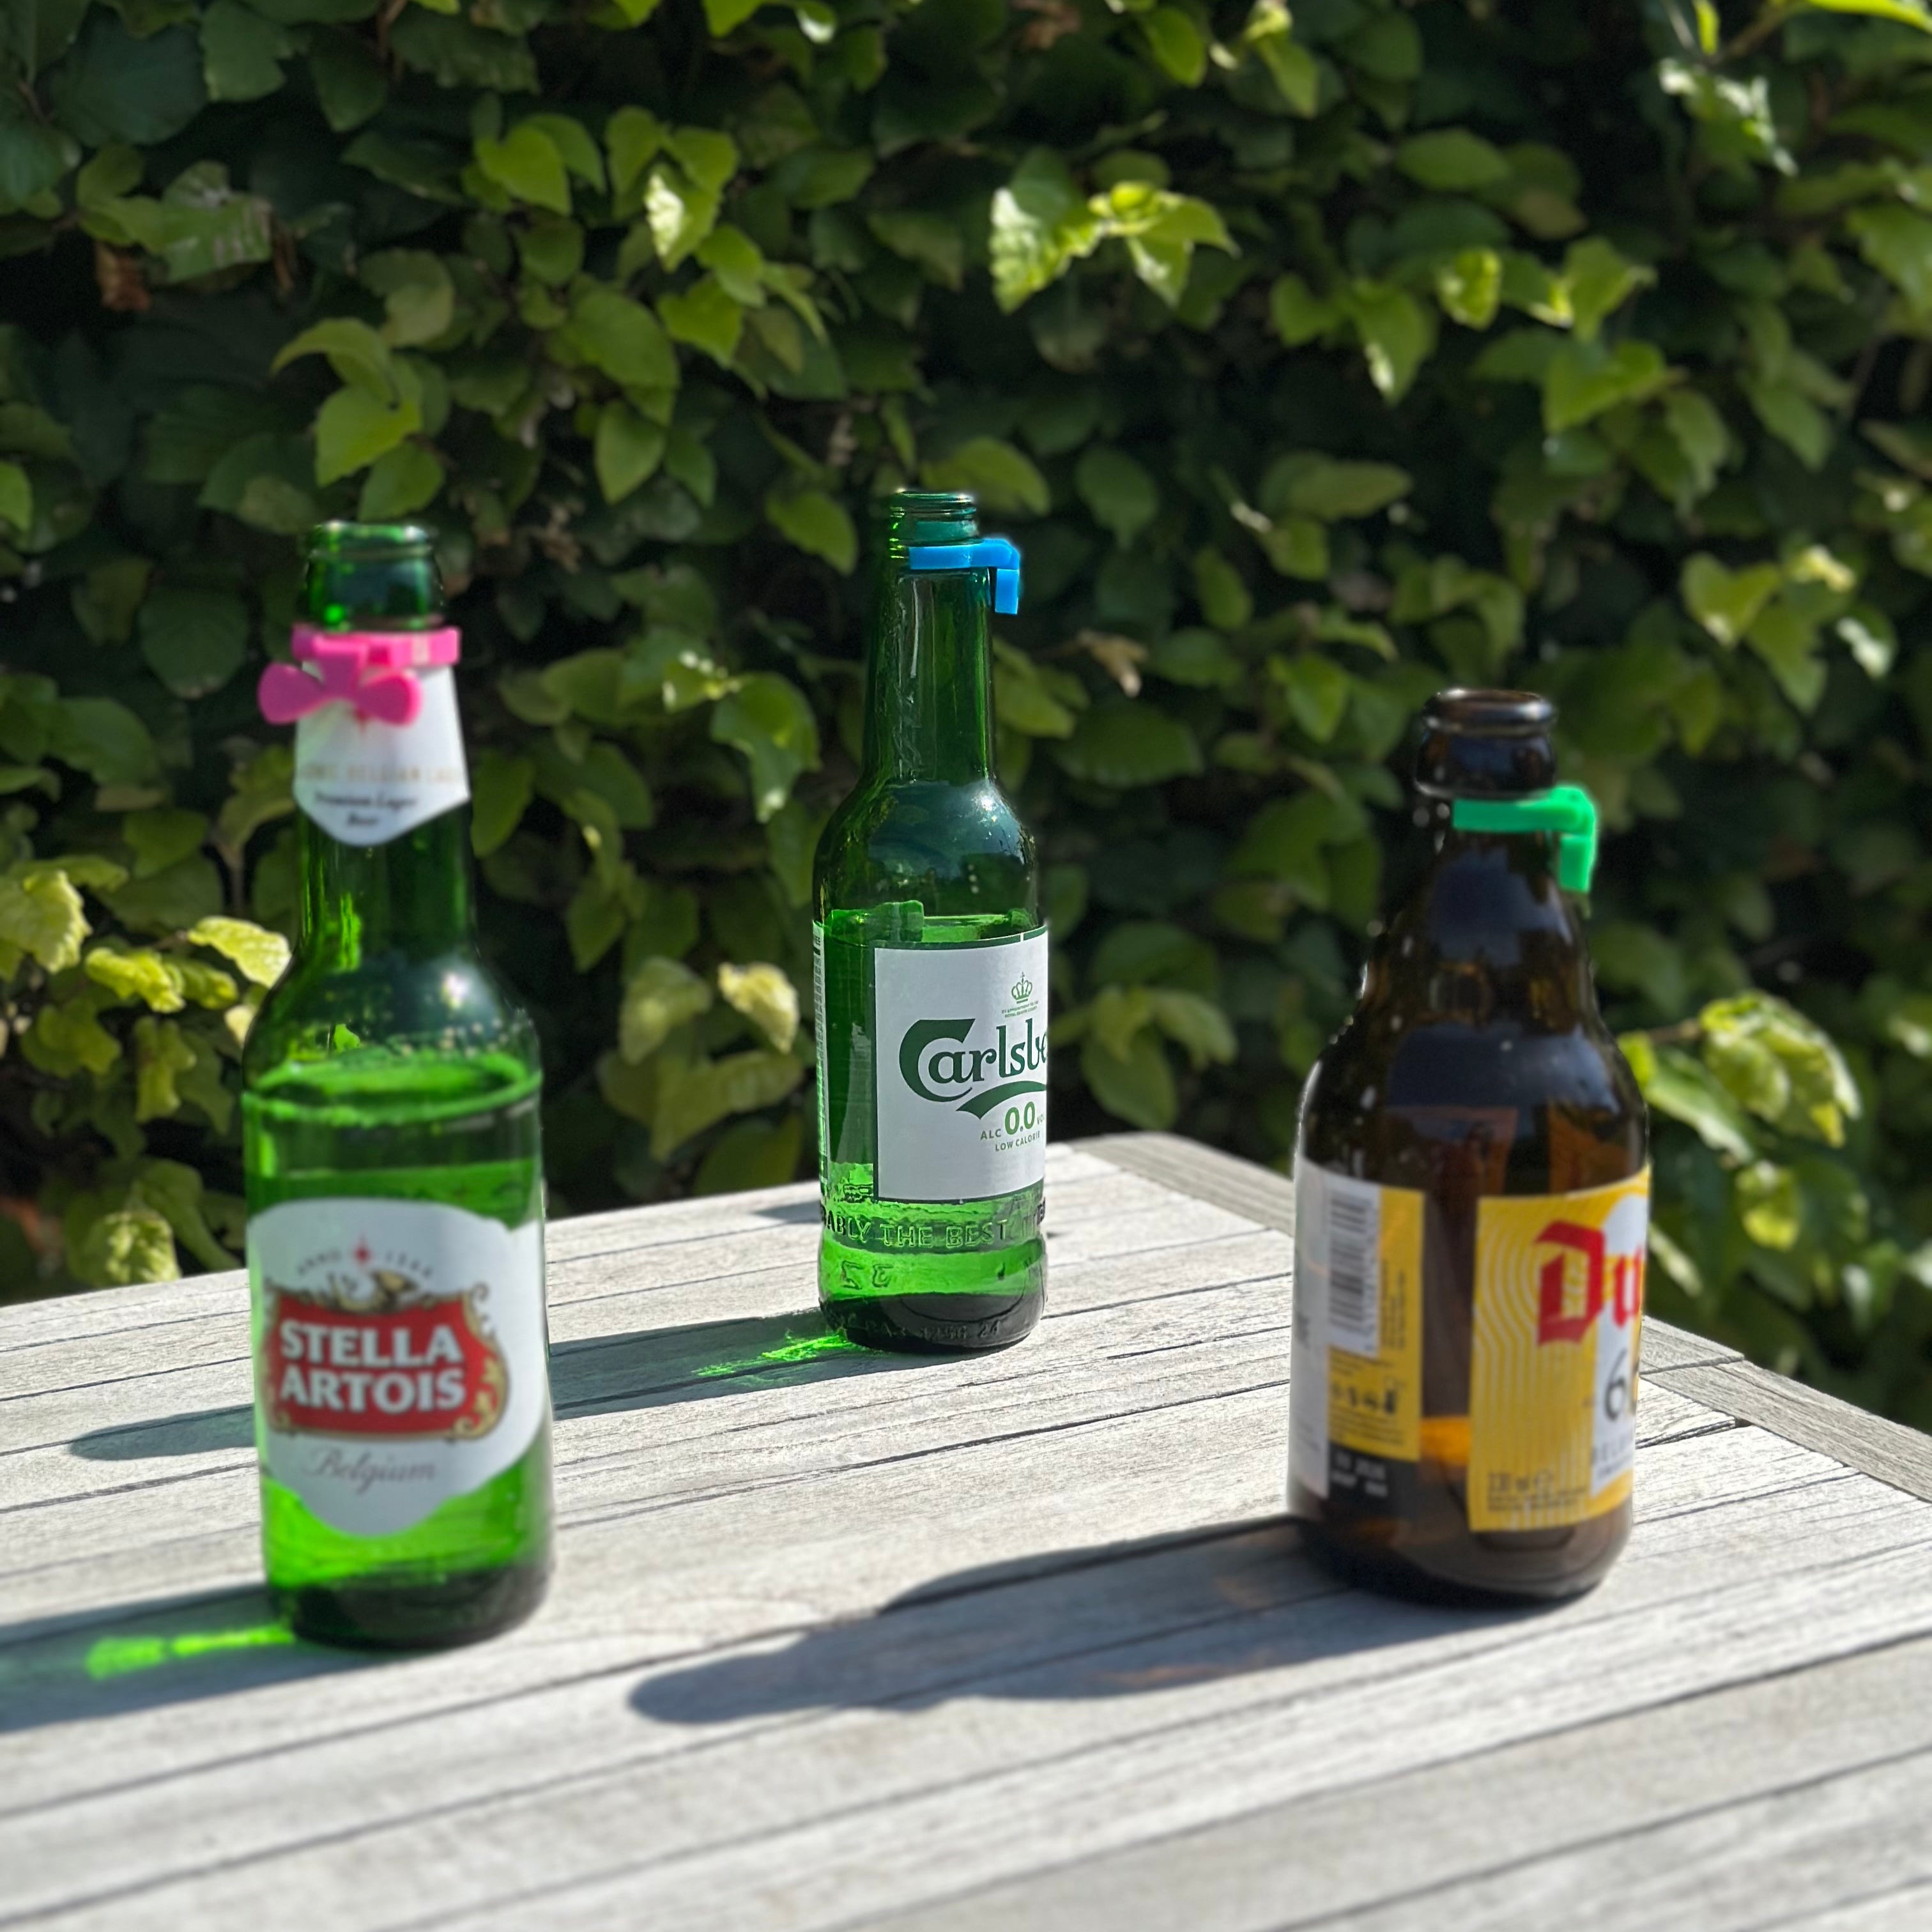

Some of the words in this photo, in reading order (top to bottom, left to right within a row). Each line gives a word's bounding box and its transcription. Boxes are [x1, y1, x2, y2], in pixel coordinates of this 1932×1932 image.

[981, 1129, 1001, 1140] ALC
[1005, 1101, 1035, 1135] 0.0
[995, 1141, 1013, 1152] LOW
[880, 1223, 933, 1248] THE
[945, 1219, 1008, 1248] BEST
[281, 1320, 461, 1367] STELLA
[281, 1365, 466, 1413] ARTOIS
[304, 1449, 435, 1493] Belgium
